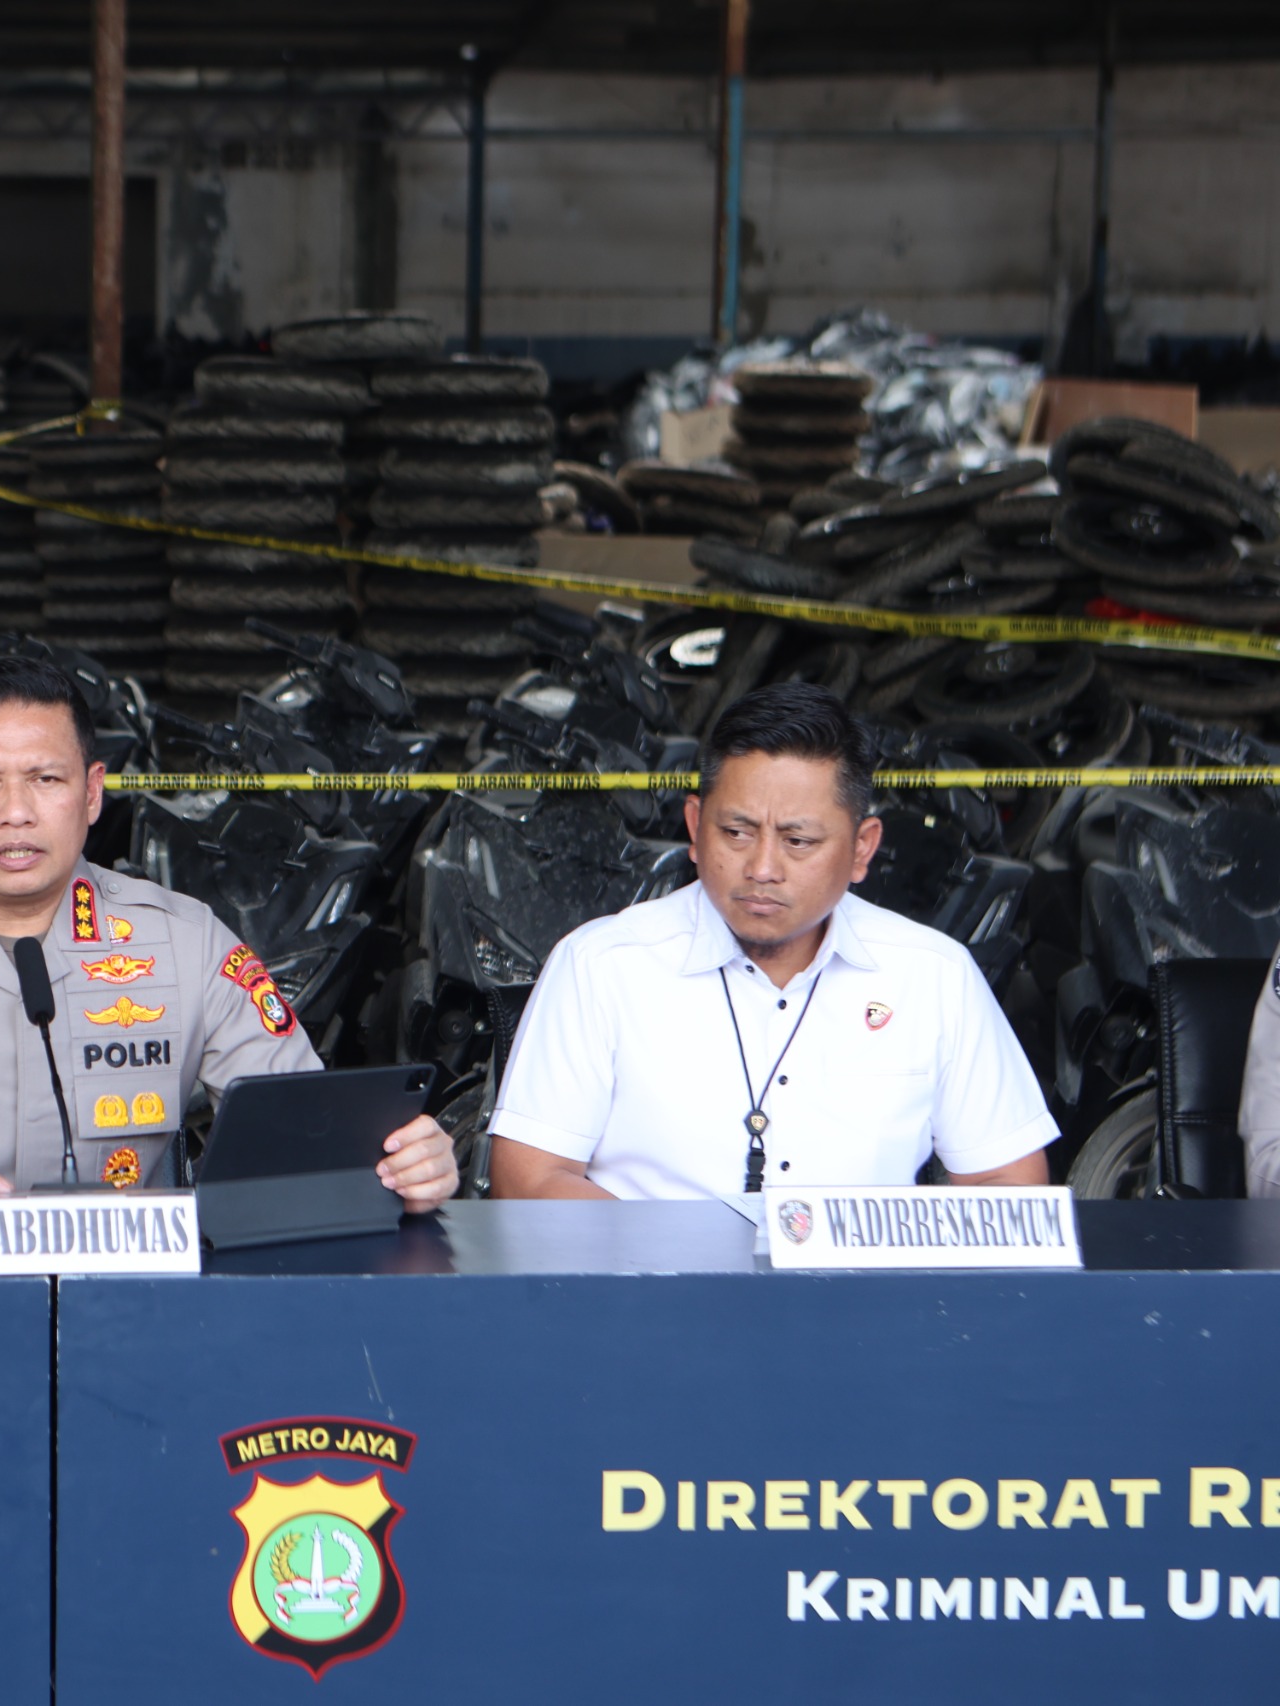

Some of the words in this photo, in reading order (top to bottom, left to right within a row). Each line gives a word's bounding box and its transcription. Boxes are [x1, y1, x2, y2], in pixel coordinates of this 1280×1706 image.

[120, 774, 190, 789] DILARANG
[195, 774, 265, 789] MELINTAS
[313, 775, 357, 789] GARIS
[362, 775, 409, 789] POLISI
[457, 775, 526, 790] DILARANG
[531, 775, 601, 790] MELINTAS
[648, 774, 693, 789] GARIS
[984, 773, 1029, 787] GARIS
[1034, 773, 1082, 787] POLISI
[1128, 772, 1200, 787] DILARANG
[1204, 771, 1274, 786] MELINTAS
[83, 1039, 171, 1070] POLRI
[823, 1198, 1067, 1247] WADIRRESKRIMUM
[235, 1427, 330, 1463] METRO
[334, 1428, 398, 1462] JAYA
[602, 1469, 1161, 1532] DIREKTORAT
[787, 1570, 1146, 1622] KRIMINAL
